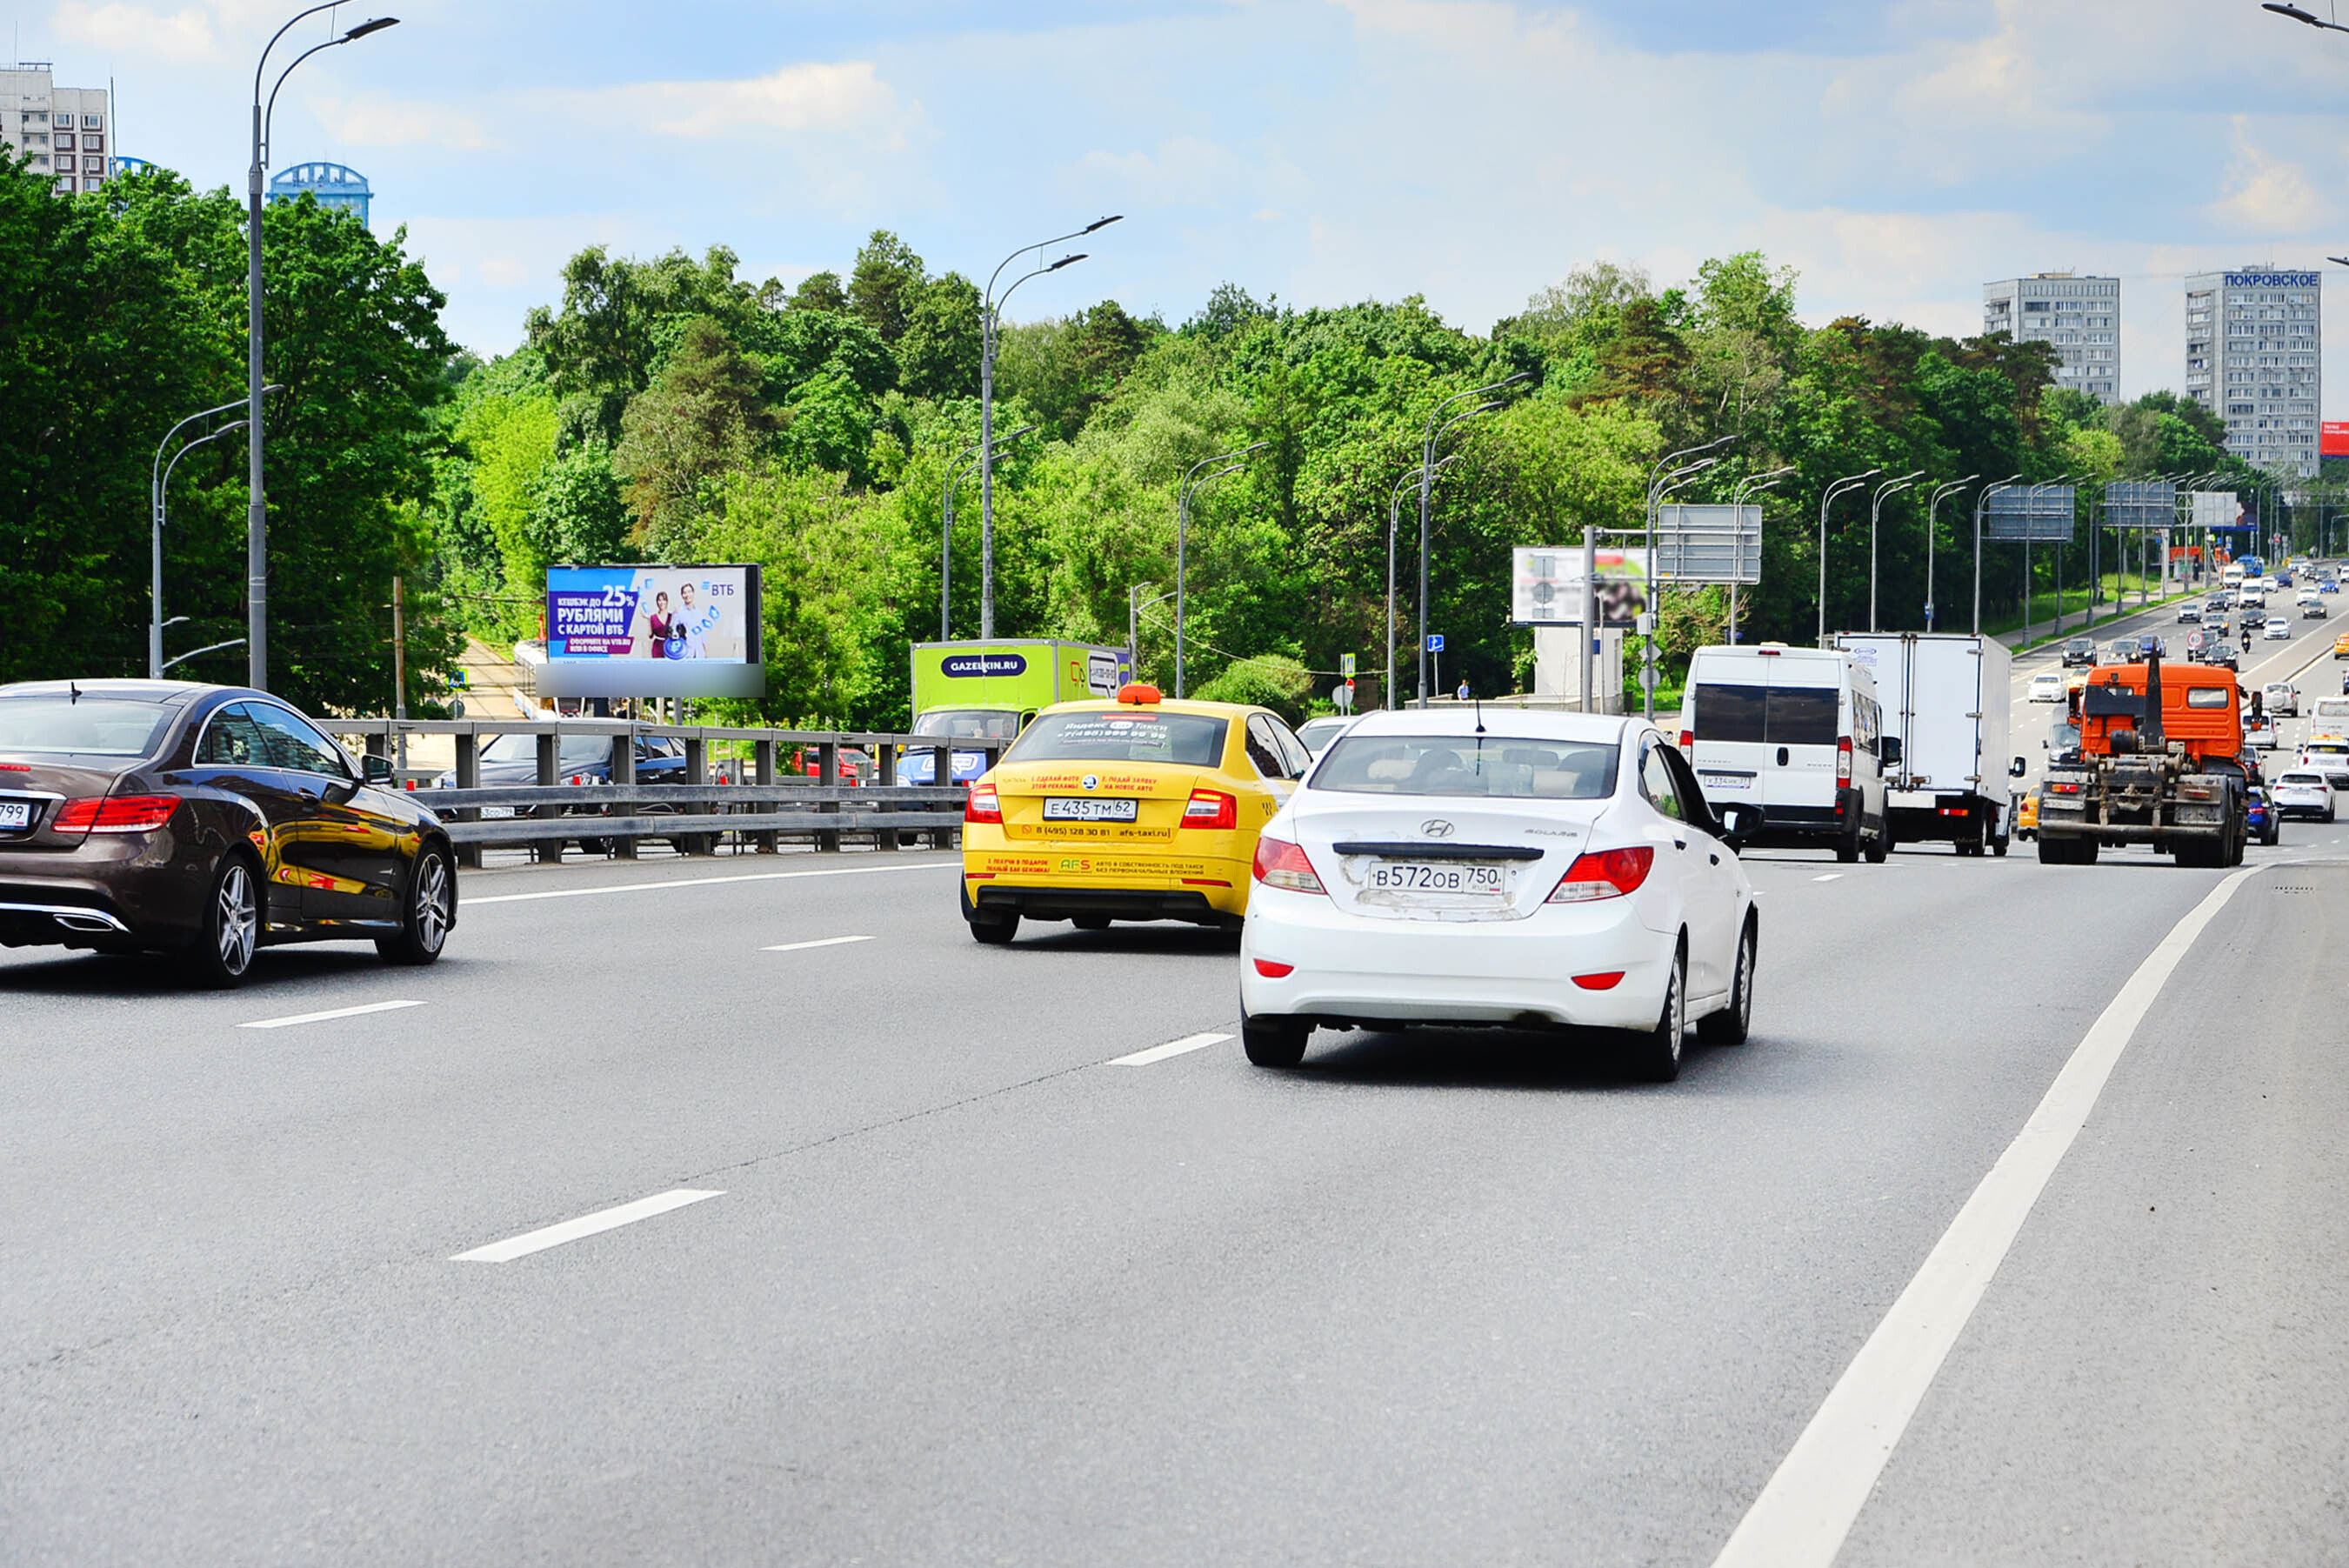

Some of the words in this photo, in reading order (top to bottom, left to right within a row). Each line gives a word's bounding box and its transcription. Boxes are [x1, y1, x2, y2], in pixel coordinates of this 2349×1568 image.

[2225, 274, 2318, 288] ПОКРОВСКОЕ
[711, 584, 734, 596] ВТБ
[590, 597, 601, 608] ДО
[603, 585, 635, 607] 25%
[557, 608, 624, 623] РУБЛЯМИ
[557, 624, 565, 635] С
[566, 623, 604, 635] КАРТОЙ
[606, 624, 624, 635] ВТБ
[950, 661, 1018, 671] GAZELKIN.RU
[1135, 723, 1168, 731] Такси
[0, 804, 23, 818] 799
[1115, 801, 1131, 812] 62
[1044, 826, 1067, 837] (495)
[1070, 827, 1084, 836] 128
[1060, 859, 1091, 870] AFS
[1377, 866, 1459, 889] В572ОВ
[1466, 868, 1497, 884] 750
